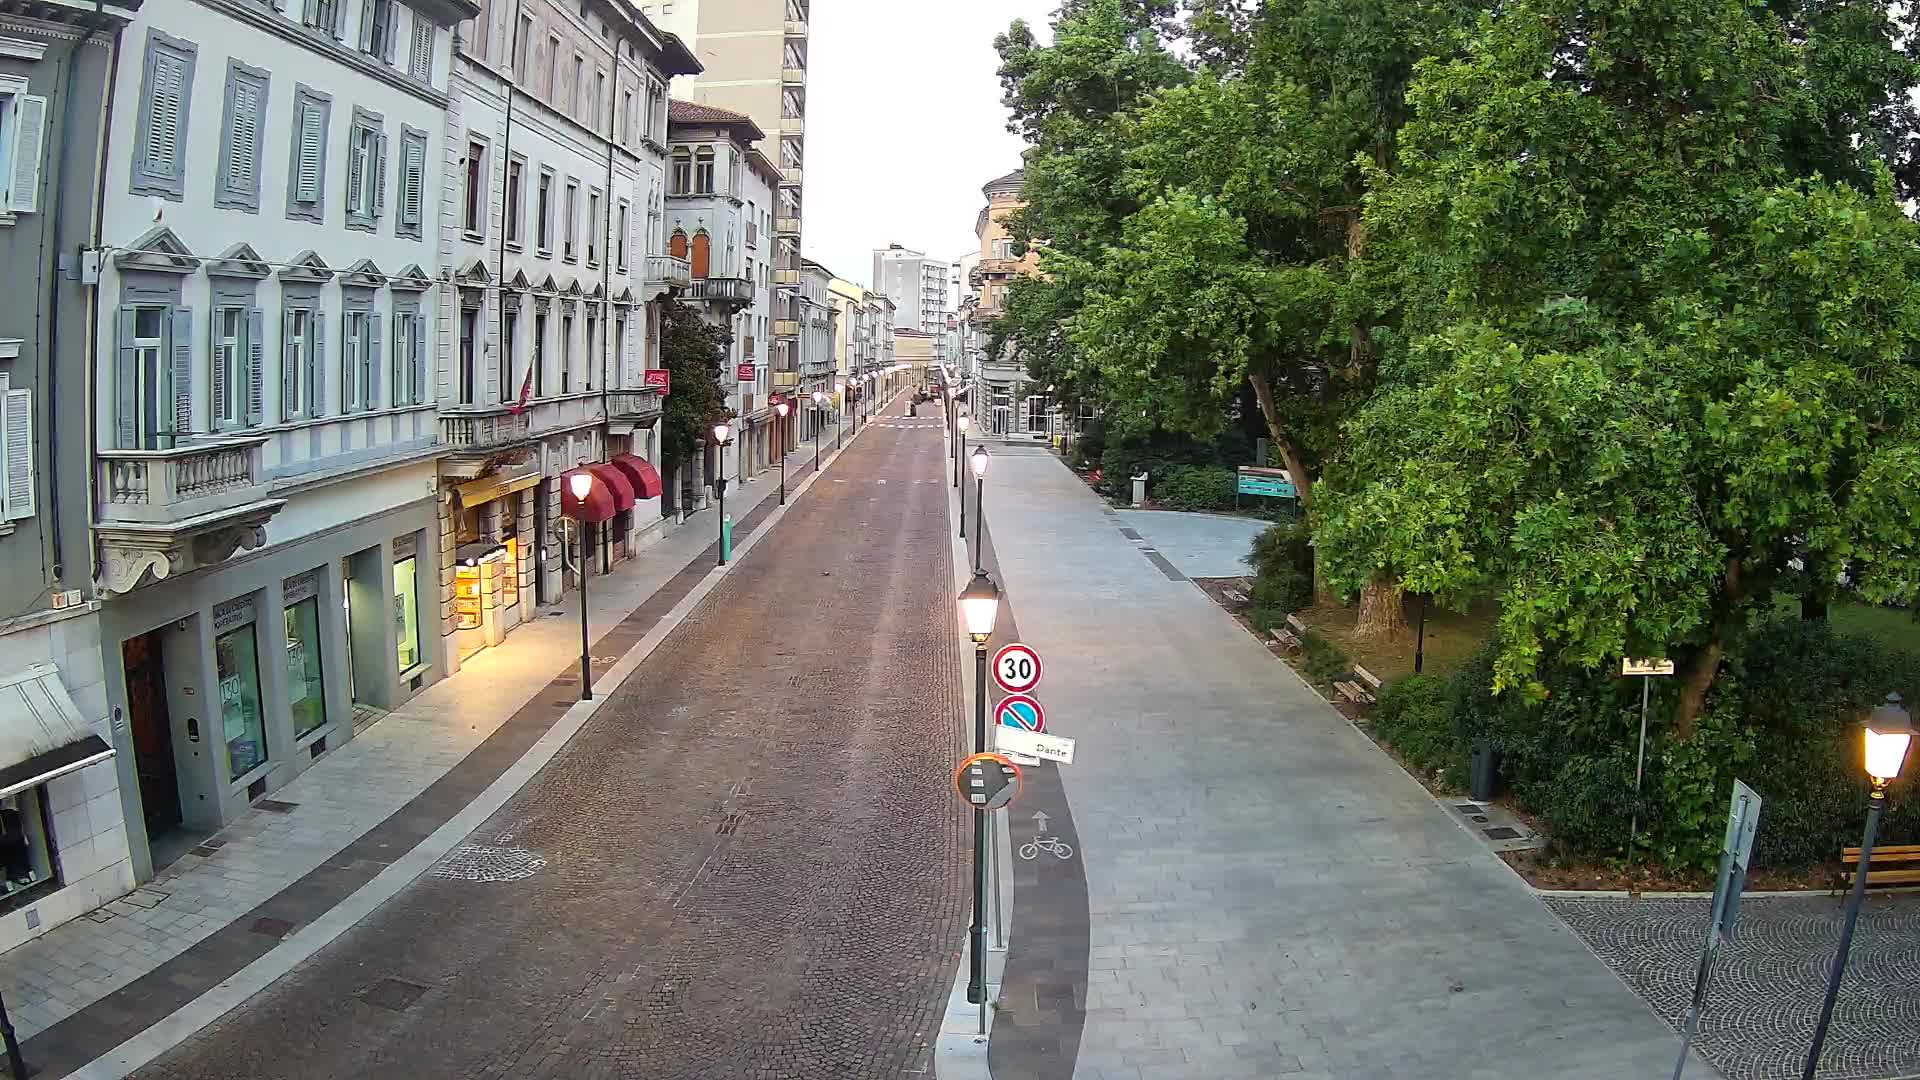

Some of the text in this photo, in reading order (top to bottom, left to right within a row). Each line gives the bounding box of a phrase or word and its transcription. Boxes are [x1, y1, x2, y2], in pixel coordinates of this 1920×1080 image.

[1005, 658, 1031, 679] 30
[222, 678, 239, 700] 130
[1036, 743, 1068, 757] Dante
